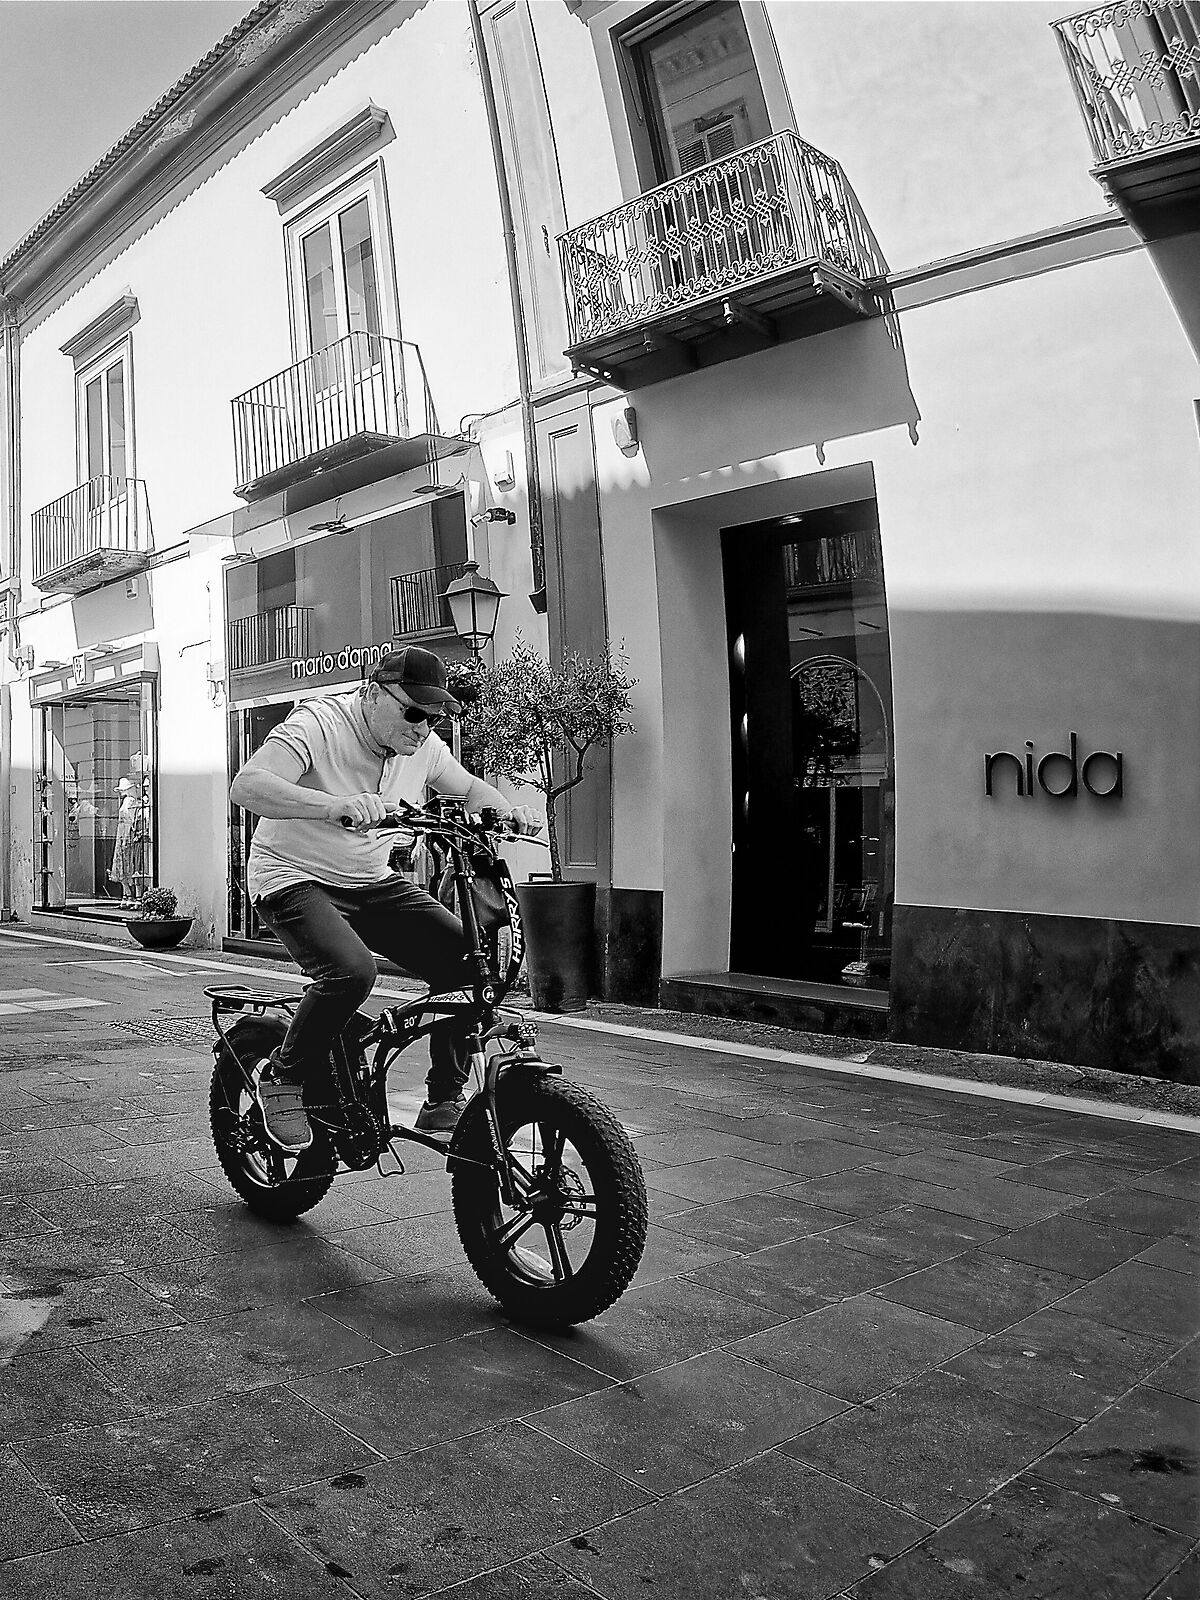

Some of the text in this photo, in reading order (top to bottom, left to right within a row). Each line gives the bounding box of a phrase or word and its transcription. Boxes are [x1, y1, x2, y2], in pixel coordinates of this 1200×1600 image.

[292, 642, 392, 679] mario d'anna
[984, 731, 1124, 797] nida
